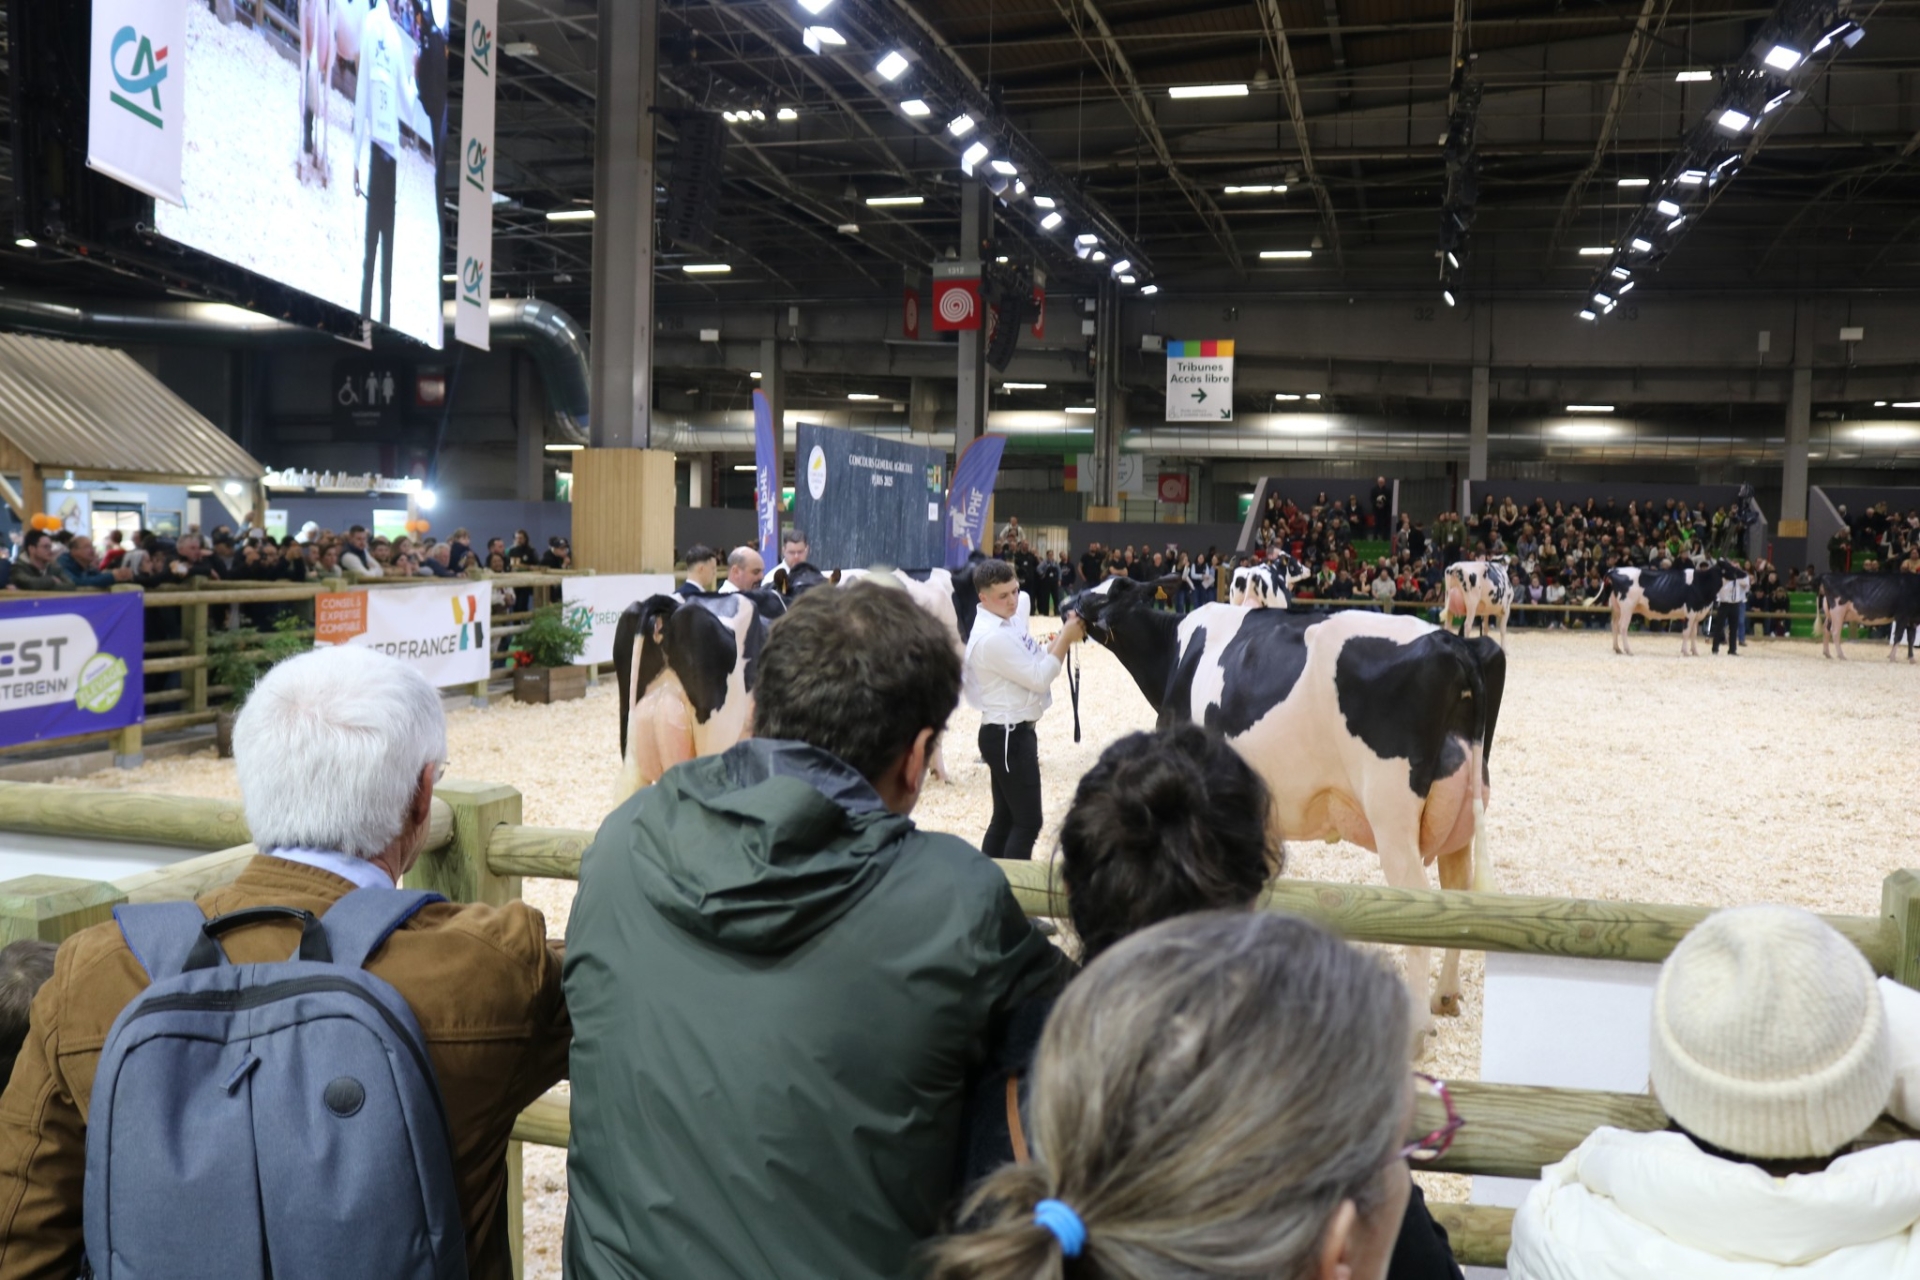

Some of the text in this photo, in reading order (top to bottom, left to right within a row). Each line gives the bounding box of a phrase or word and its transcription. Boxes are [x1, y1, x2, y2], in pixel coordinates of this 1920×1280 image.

[948, 266, 964, 275] 1312
[1415, 306, 1435, 321] 32
[1177, 362, 1223, 372] Tribunes
[1170, 373, 1230, 383] Accès libre
[967, 487, 984, 517] PHF
[367, 634, 457, 660] ERFRANCE
[0, 677, 69, 701] TERENN
